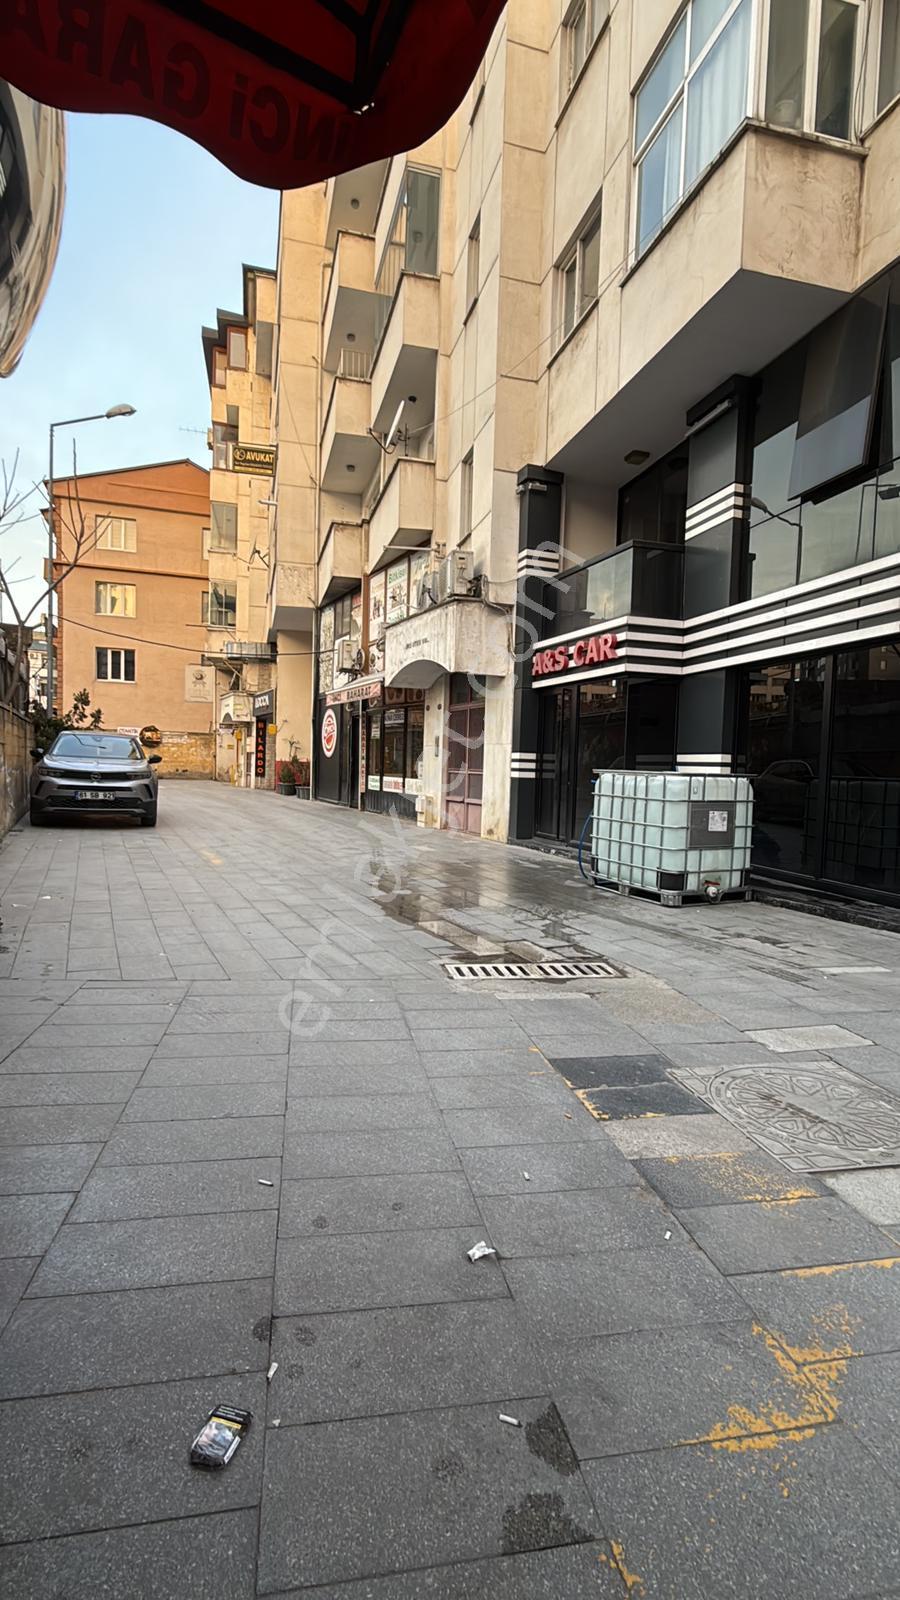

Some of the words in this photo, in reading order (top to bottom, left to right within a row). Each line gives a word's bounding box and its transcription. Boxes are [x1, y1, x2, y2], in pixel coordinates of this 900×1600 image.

[245, 450, 274, 463] AVUKAT
[532, 646, 569, 676] A&S
[573, 633, 618, 667] CAR
